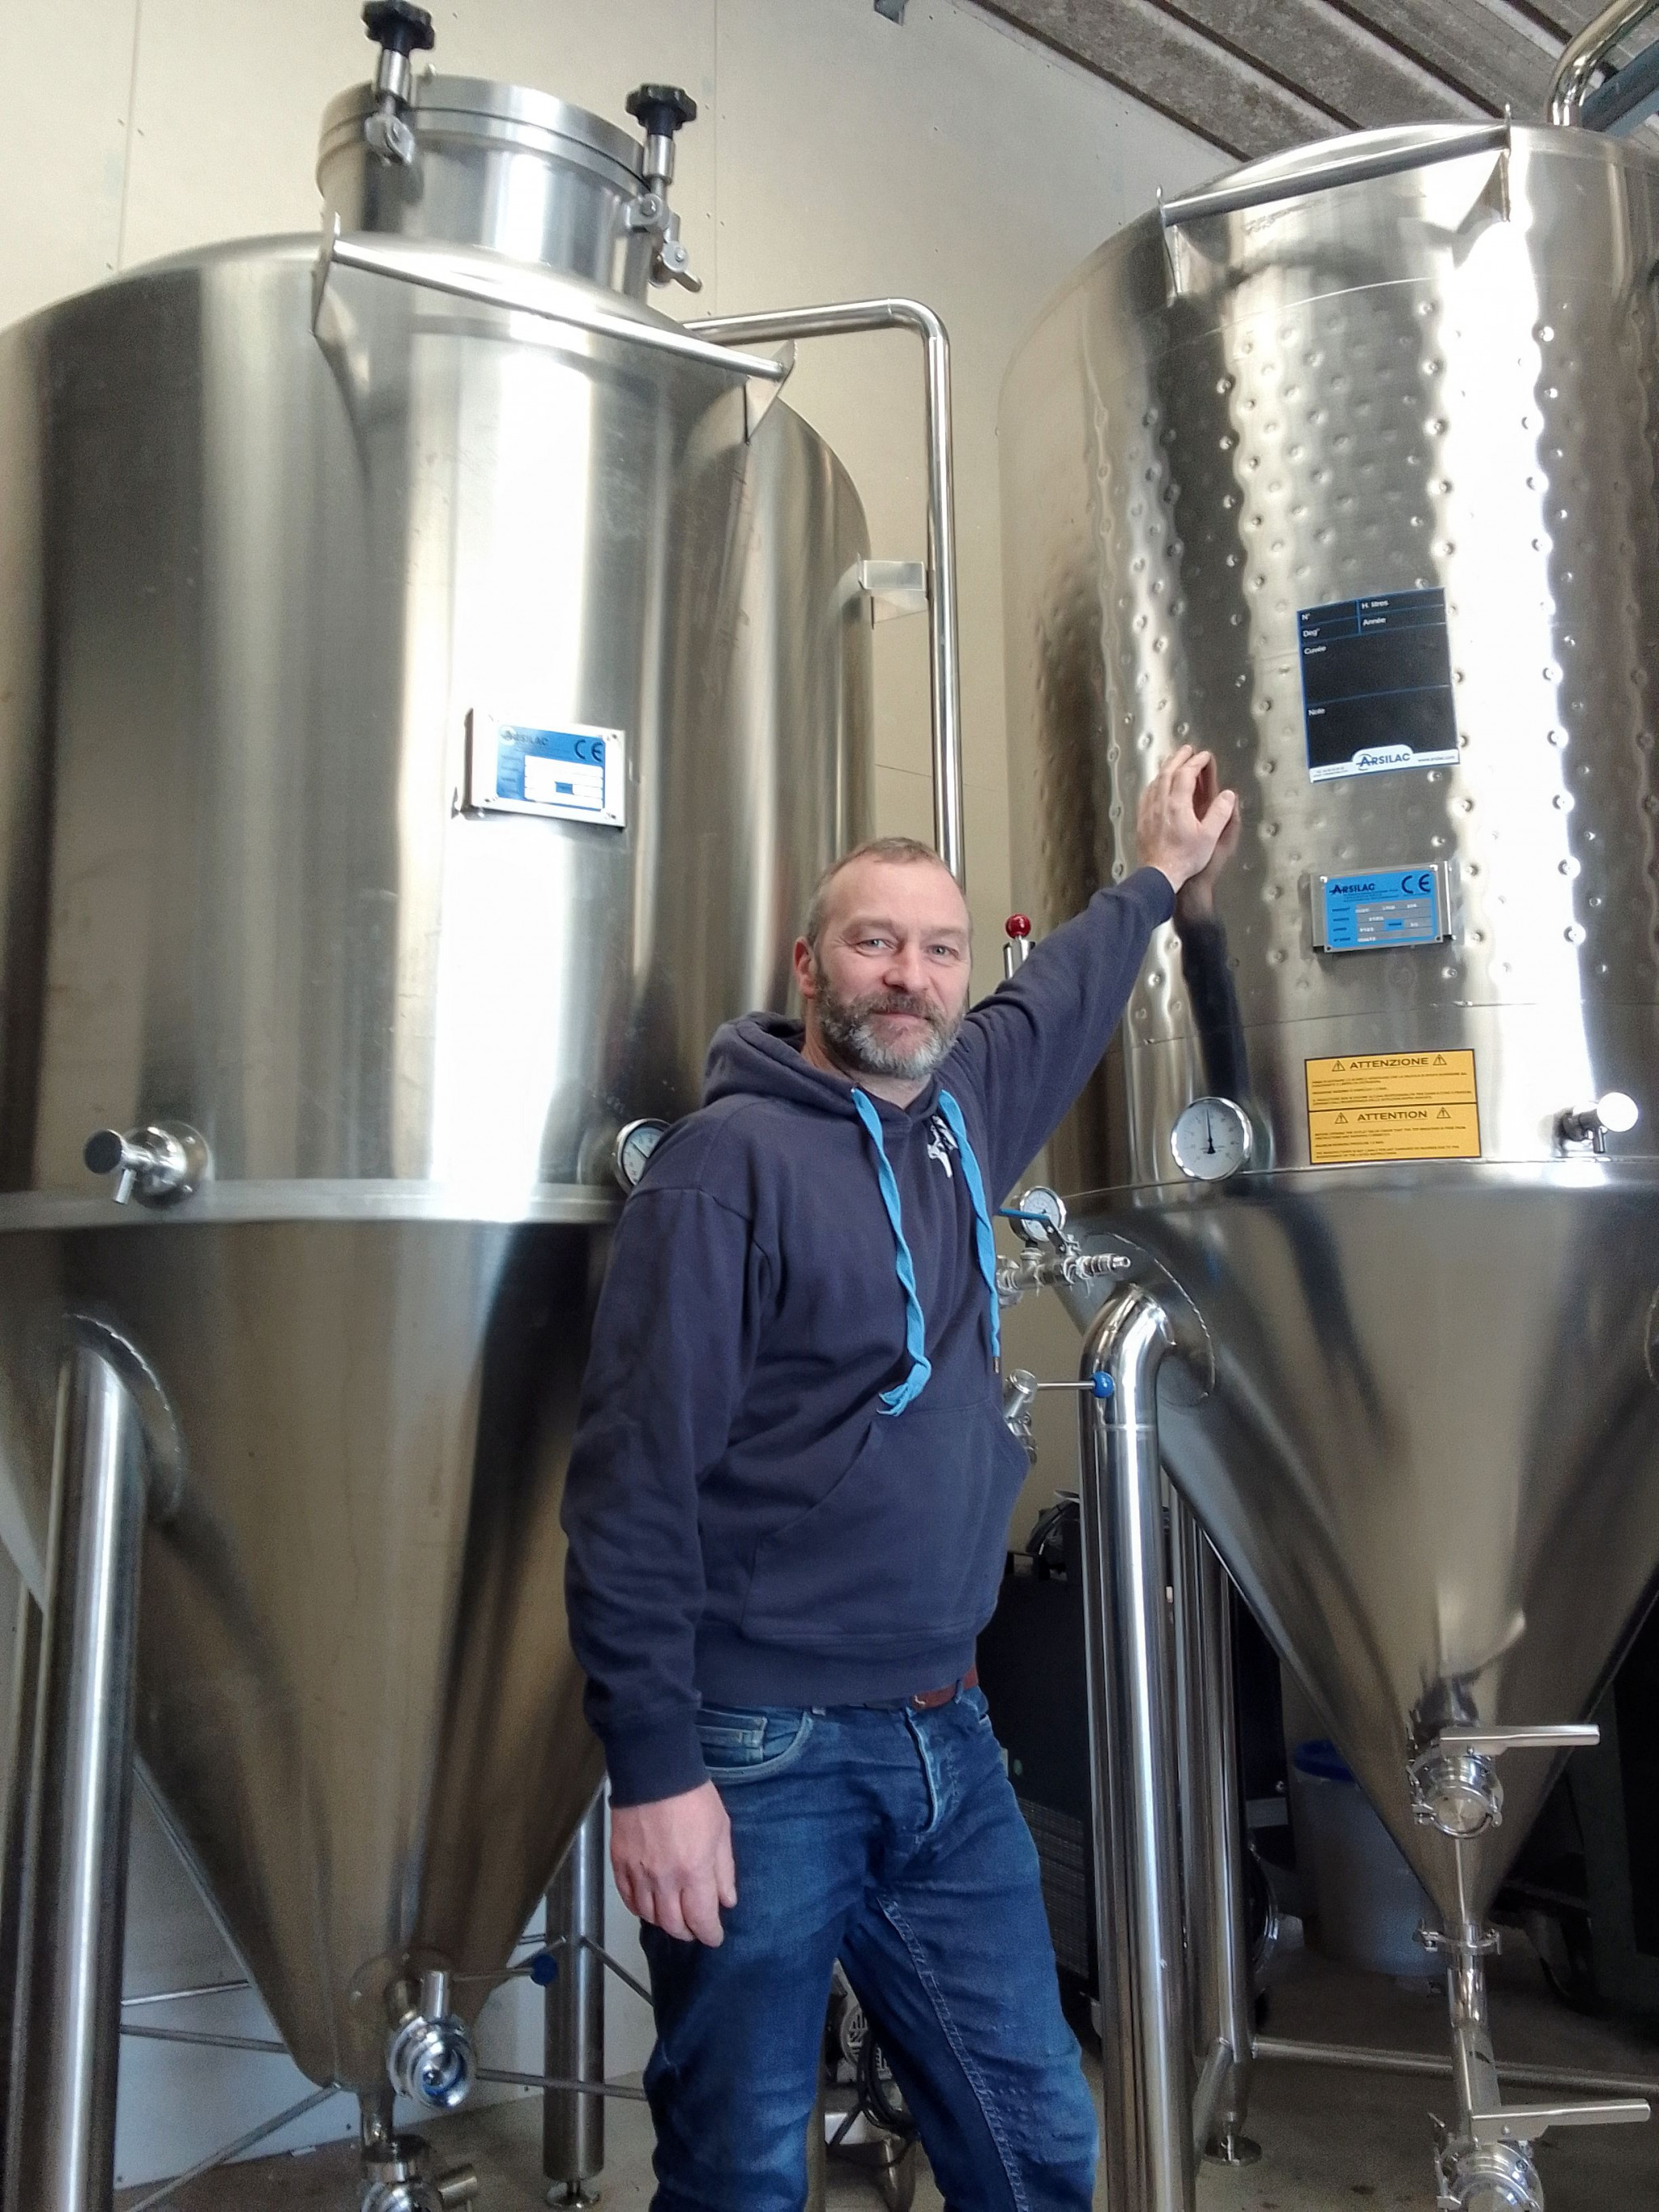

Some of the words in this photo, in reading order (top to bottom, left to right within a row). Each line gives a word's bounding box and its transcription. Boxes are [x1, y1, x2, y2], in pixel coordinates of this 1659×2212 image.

[1357, 752, 1410, 769] ARSILAC
[1328, 882, 1376, 895] ARSILAC
[1350, 1057, 1429, 1070] ATTENZIONE
[1357, 1110, 1427, 1122] ATTENTION
